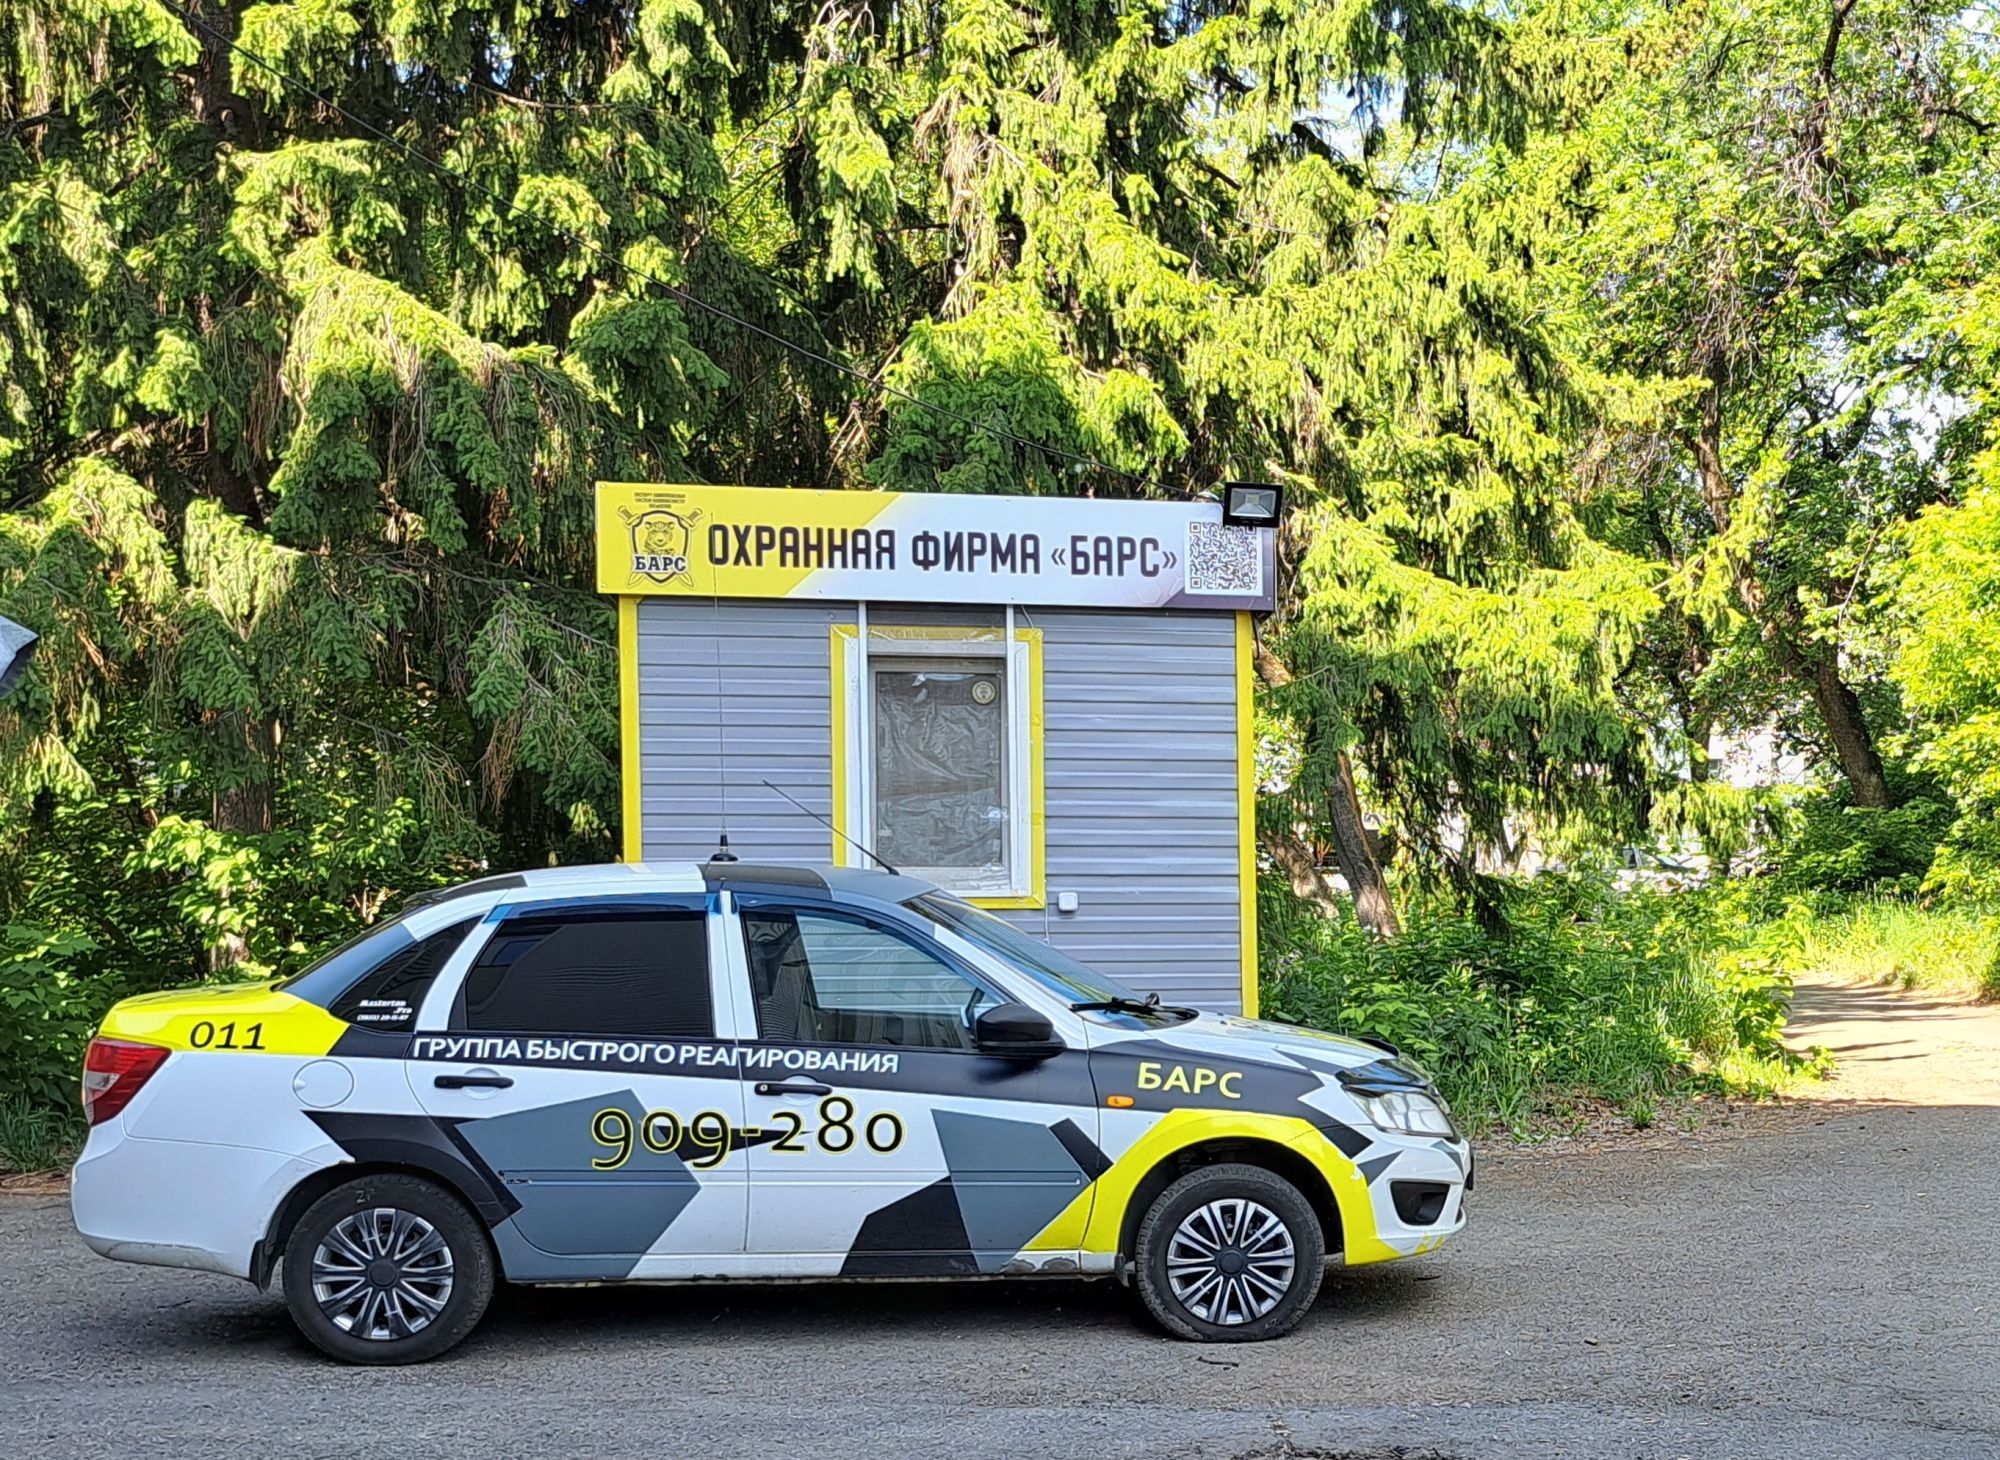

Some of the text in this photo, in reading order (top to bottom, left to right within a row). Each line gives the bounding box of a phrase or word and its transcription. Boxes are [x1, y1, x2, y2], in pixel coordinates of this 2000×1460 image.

[634, 555, 687, 572] БАРС
[708, 523, 1178, 577] ОХРАННАЯ ФИРМА «БАРС»
[189, 1021, 266, 1051] 011
[412, 1037, 899, 1073] ГРУППА БЫСТРОГО РЕАГИРОВАНИЯ
[1138, 1062, 1243, 1098] БАРС
[591, 1096, 904, 1170] 909-280
